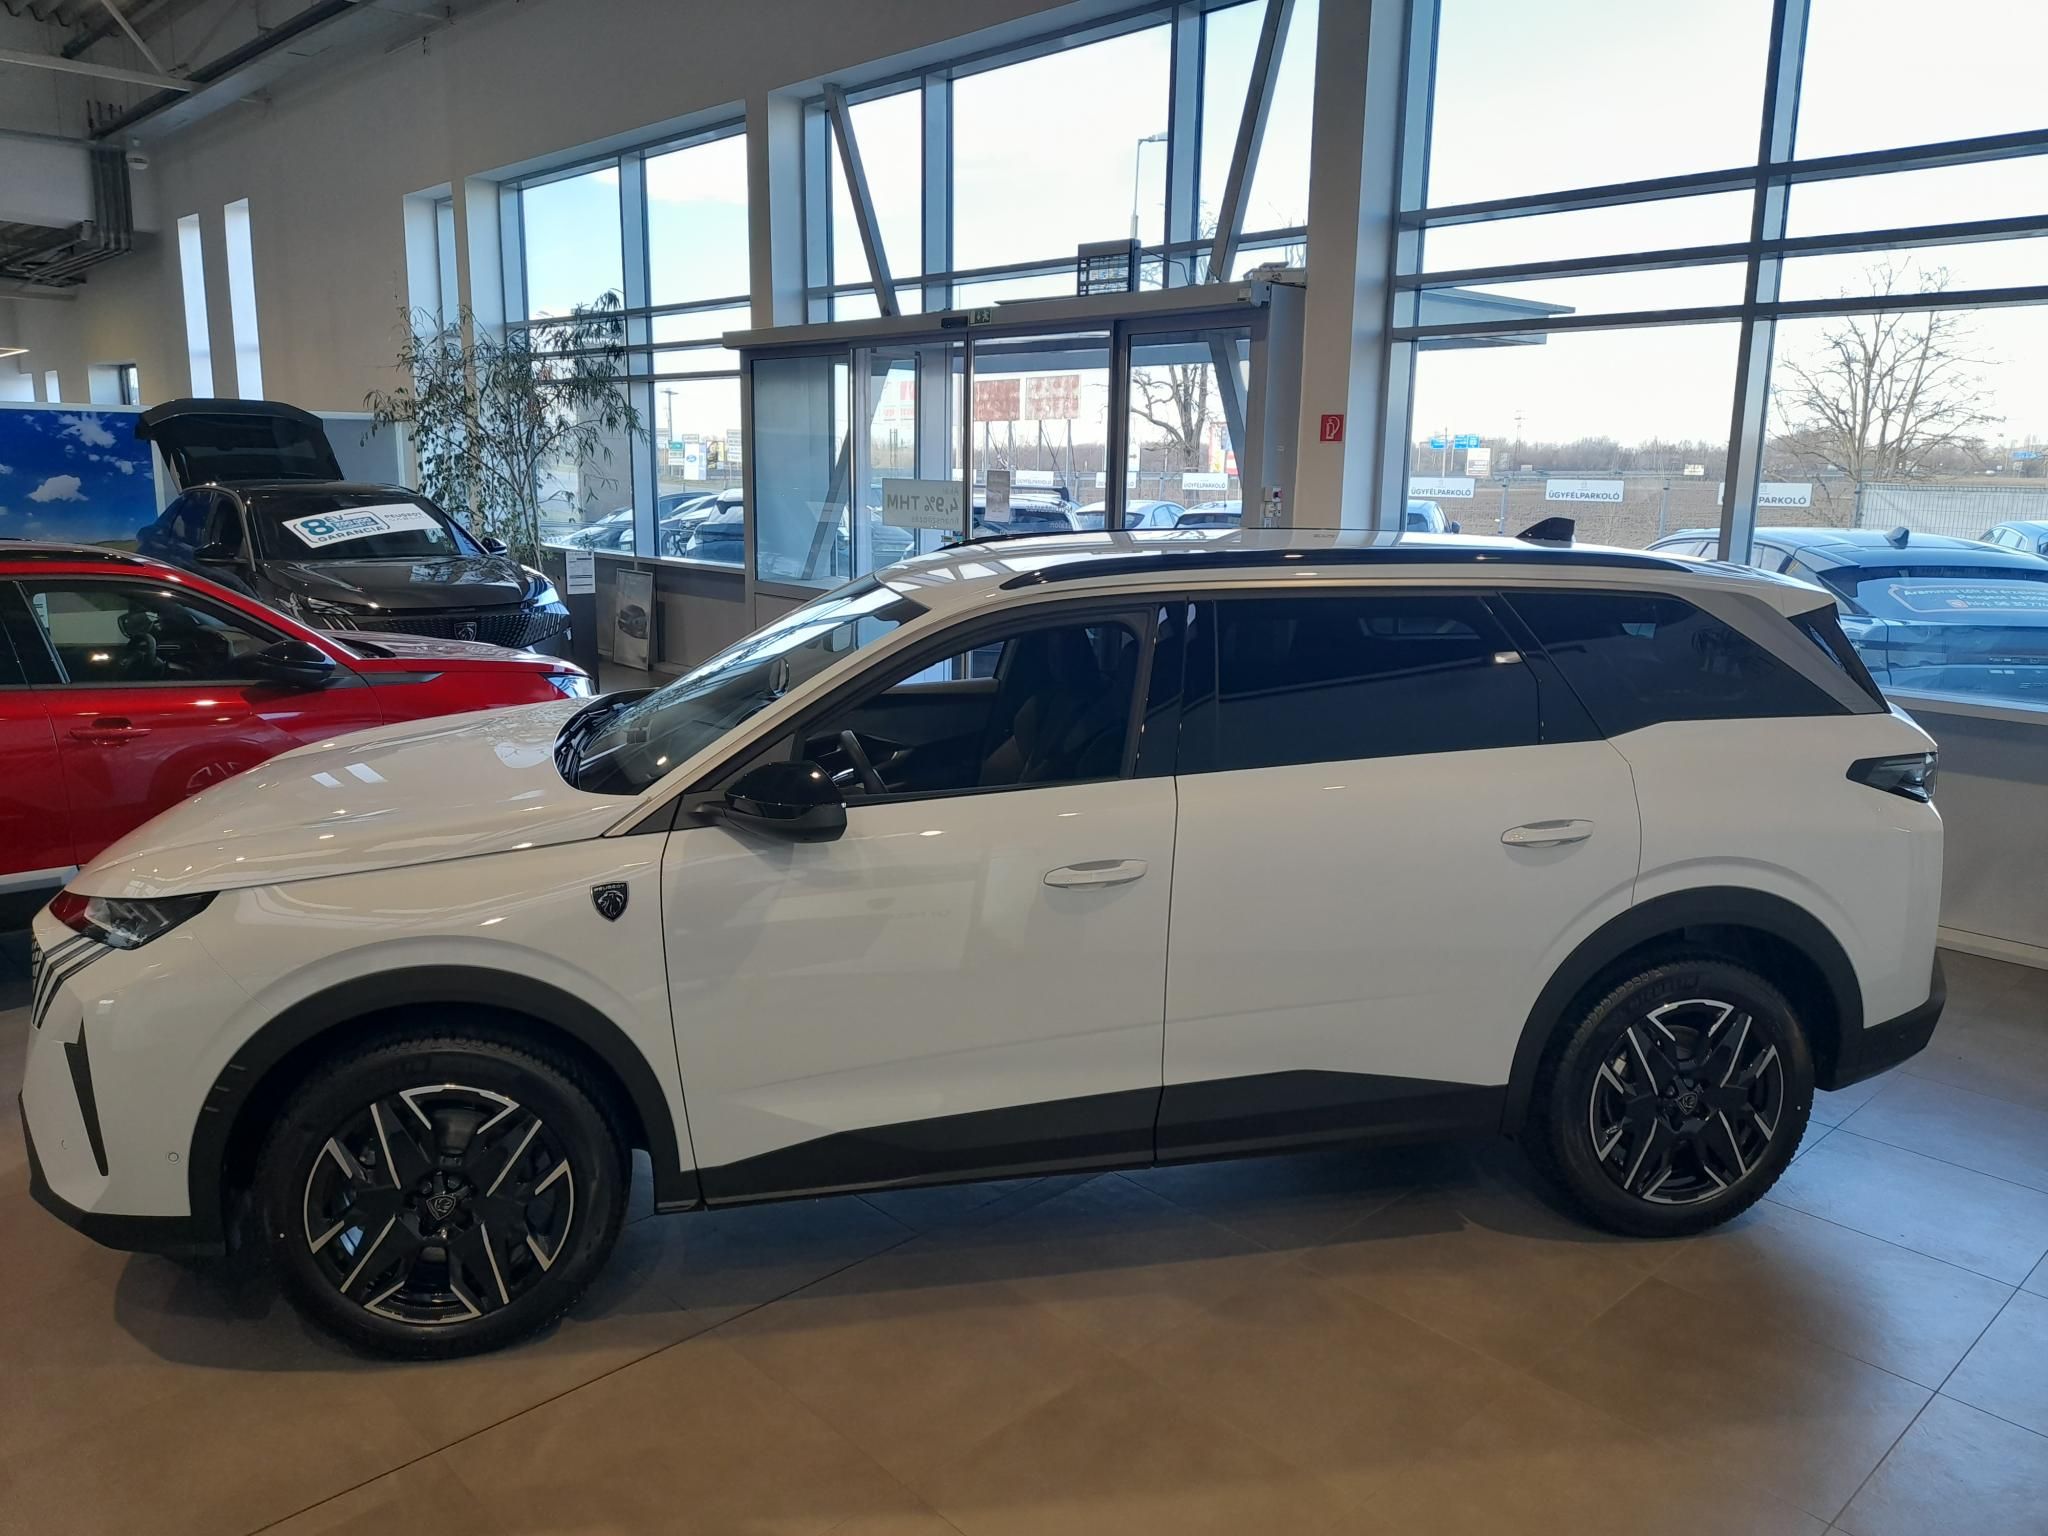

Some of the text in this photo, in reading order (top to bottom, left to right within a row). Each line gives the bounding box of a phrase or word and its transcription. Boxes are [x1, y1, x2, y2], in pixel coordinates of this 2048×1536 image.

[1411, 487, 1472, 497] ÜGYFÉLPARKOLÓ
[1548, 490, 1620, 501] ÜGYFÉLPARKOLÓ
[1758, 495, 1807, 505] PARKOLÓ
[300, 518, 336, 536] 8
[317, 525, 386, 543] GARANCIA
